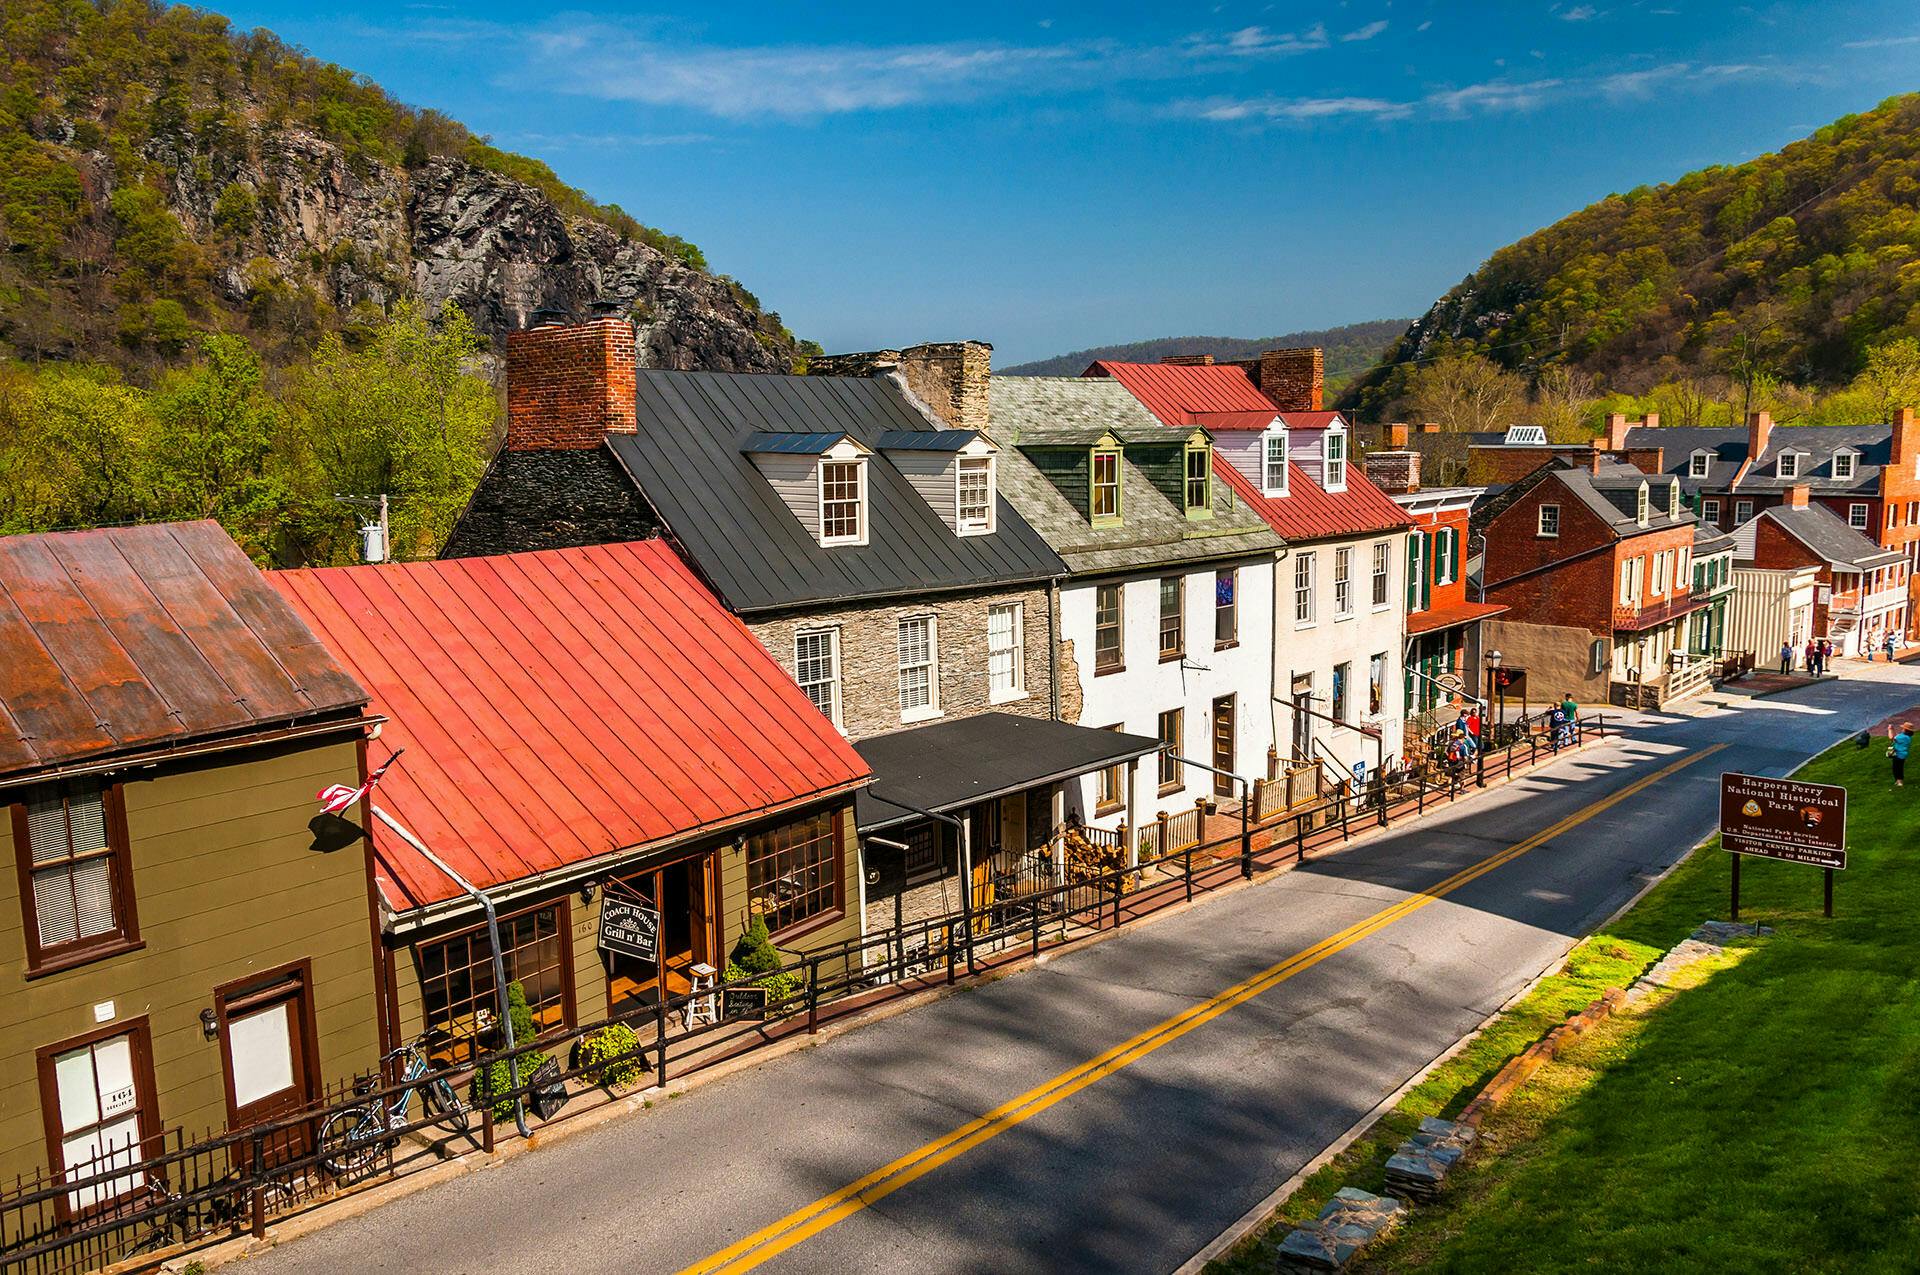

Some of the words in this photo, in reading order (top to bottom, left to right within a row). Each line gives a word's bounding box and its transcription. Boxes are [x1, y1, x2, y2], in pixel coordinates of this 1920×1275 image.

[1727, 785, 1775, 798] National
[1780, 792, 1839, 807] Historical
[1742, 778, 1788, 791] Harpers
[1791, 784, 1823, 796] Ferry
[1768, 801, 1795, 811] Park
[1742, 829, 1782, 839] Department
[1808, 839, 1837, 848] Interior
[1743, 825, 1772, 833] National
[1774, 828, 1791, 836] Park
[1734, 837, 1763, 846] VISITOR
[1765, 842, 1795, 852] CENTER
[1798, 847, 1832, 857] PARKING
[1744, 846, 1769, 854] AHEAD
[1797, 854, 1821, 862] MILES
[578, 921, 592, 933] 160
[604, 906, 631, 920] COACH
[632, 908, 657, 934] HOUSE
[605, 925, 625, 939] Grill
[636, 934, 653, 947] Bar
